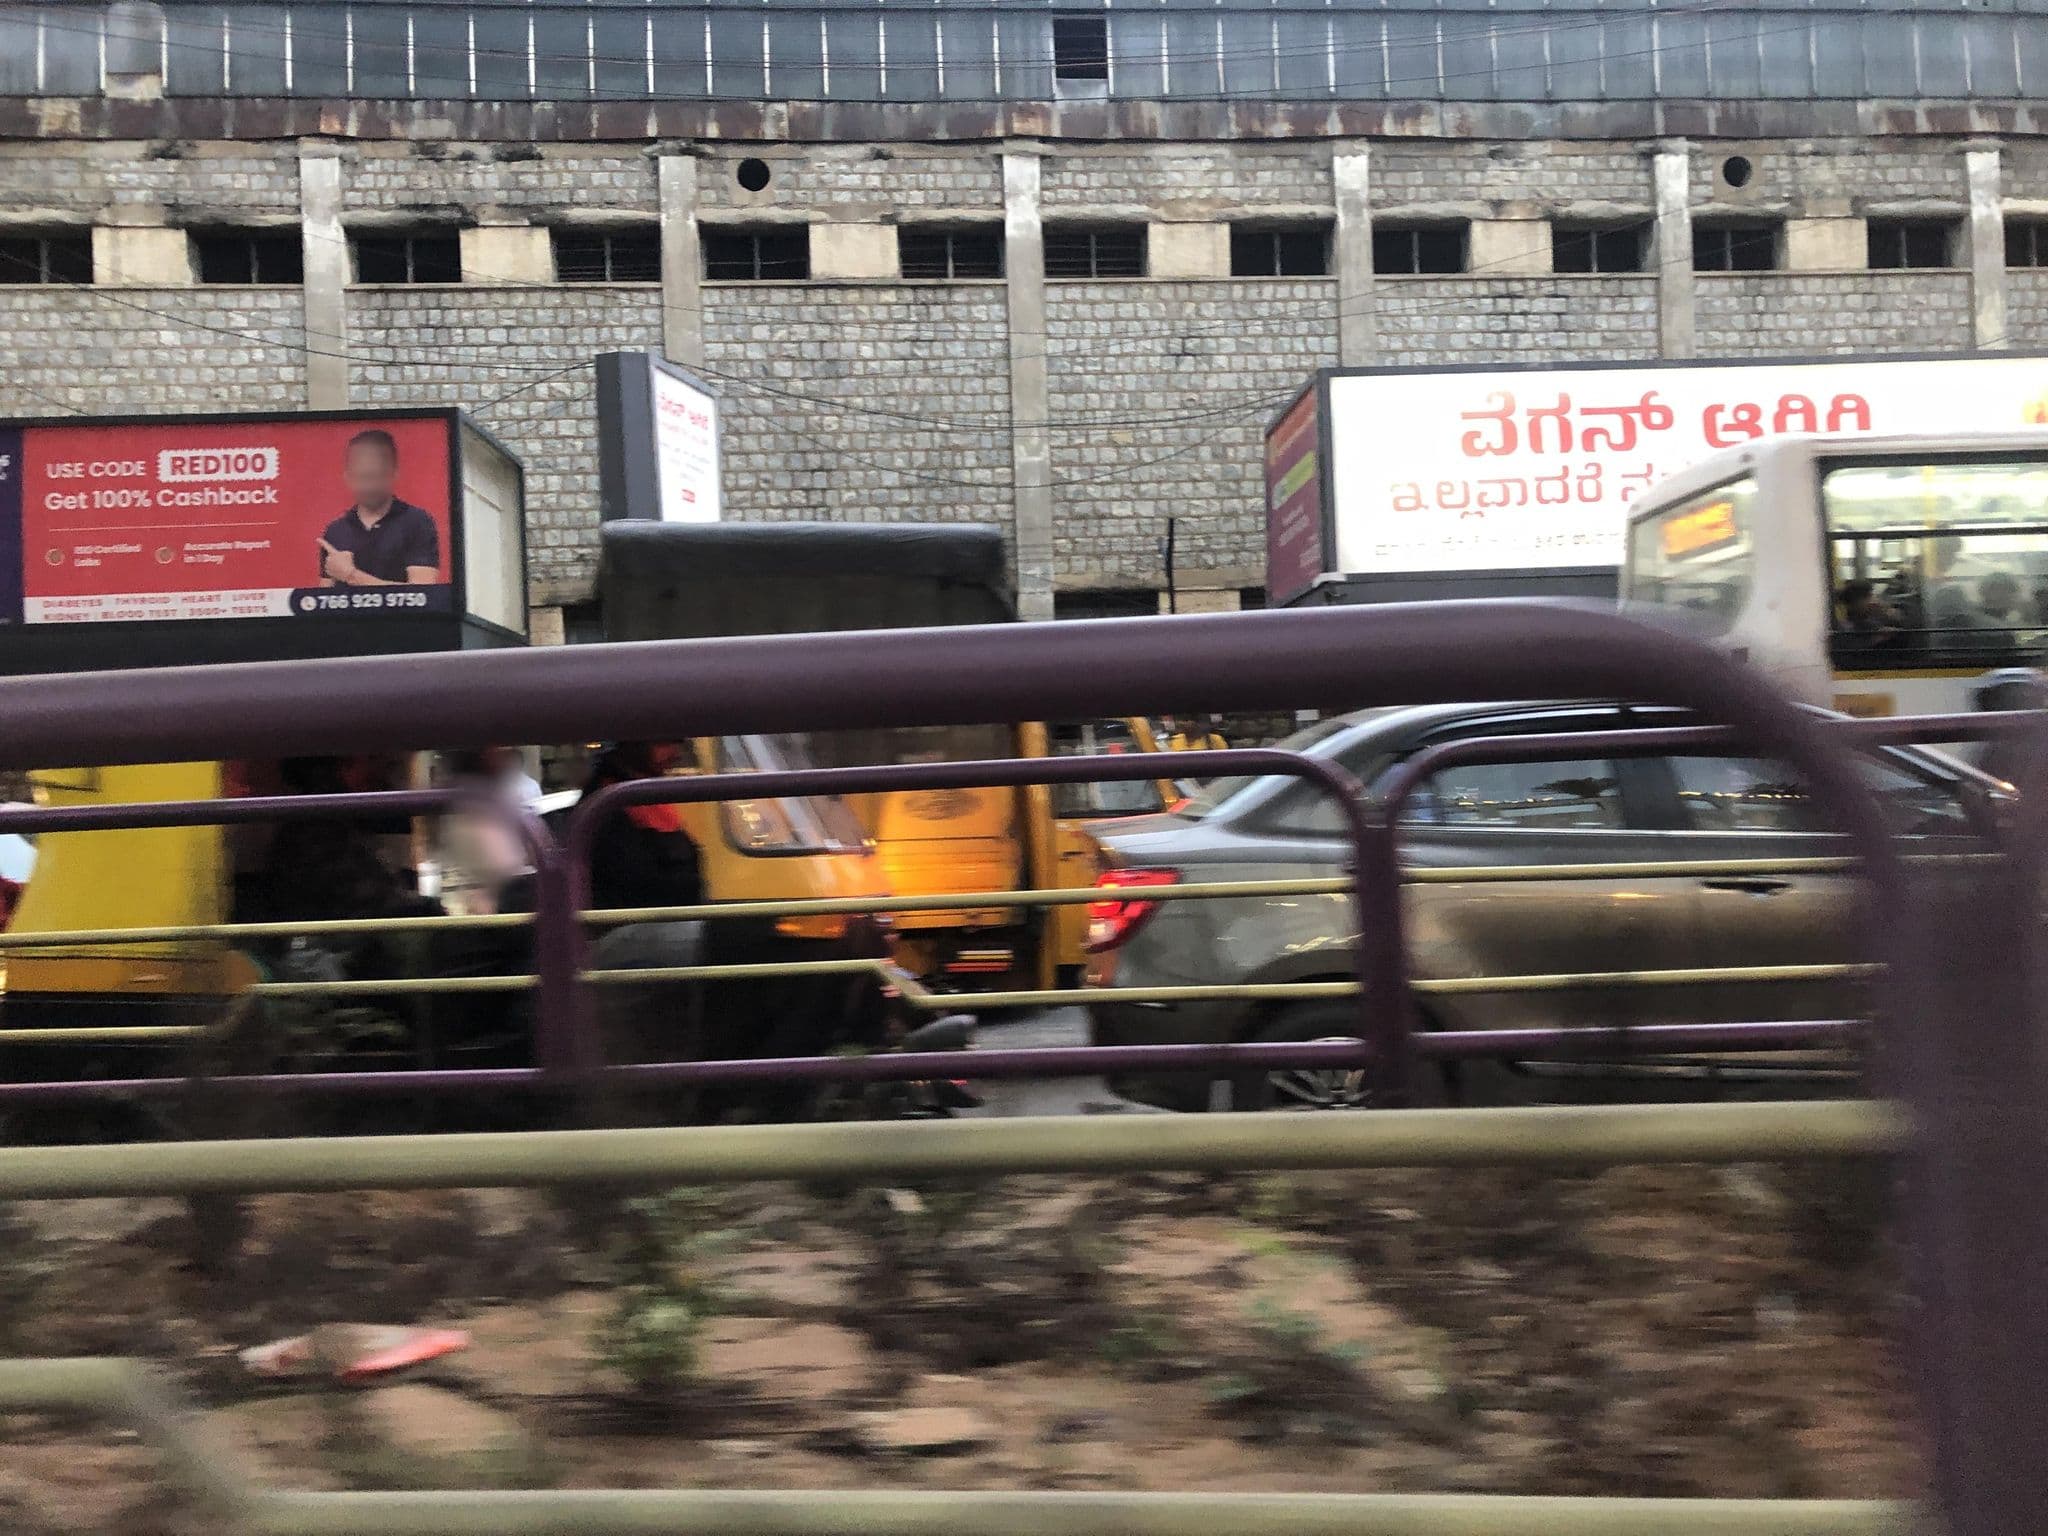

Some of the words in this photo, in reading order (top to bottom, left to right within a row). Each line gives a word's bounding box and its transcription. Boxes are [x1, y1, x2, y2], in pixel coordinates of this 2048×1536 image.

[1461, 390, 1674, 457] ವೆಗನ್
[46, 462, 85, 479] USE
[88, 460, 147, 477] CODE
[170, 453, 267, 476] RED100
[44, 492, 88, 510] Get
[92, 489, 152, 509] 100%
[156, 485, 279, 507] Cashback
[1390, 462, 1602, 520] ಇಲ್ಲವಾದರೆ
[317, 595, 349, 610] 766
[351, 593, 383, 608] 929
